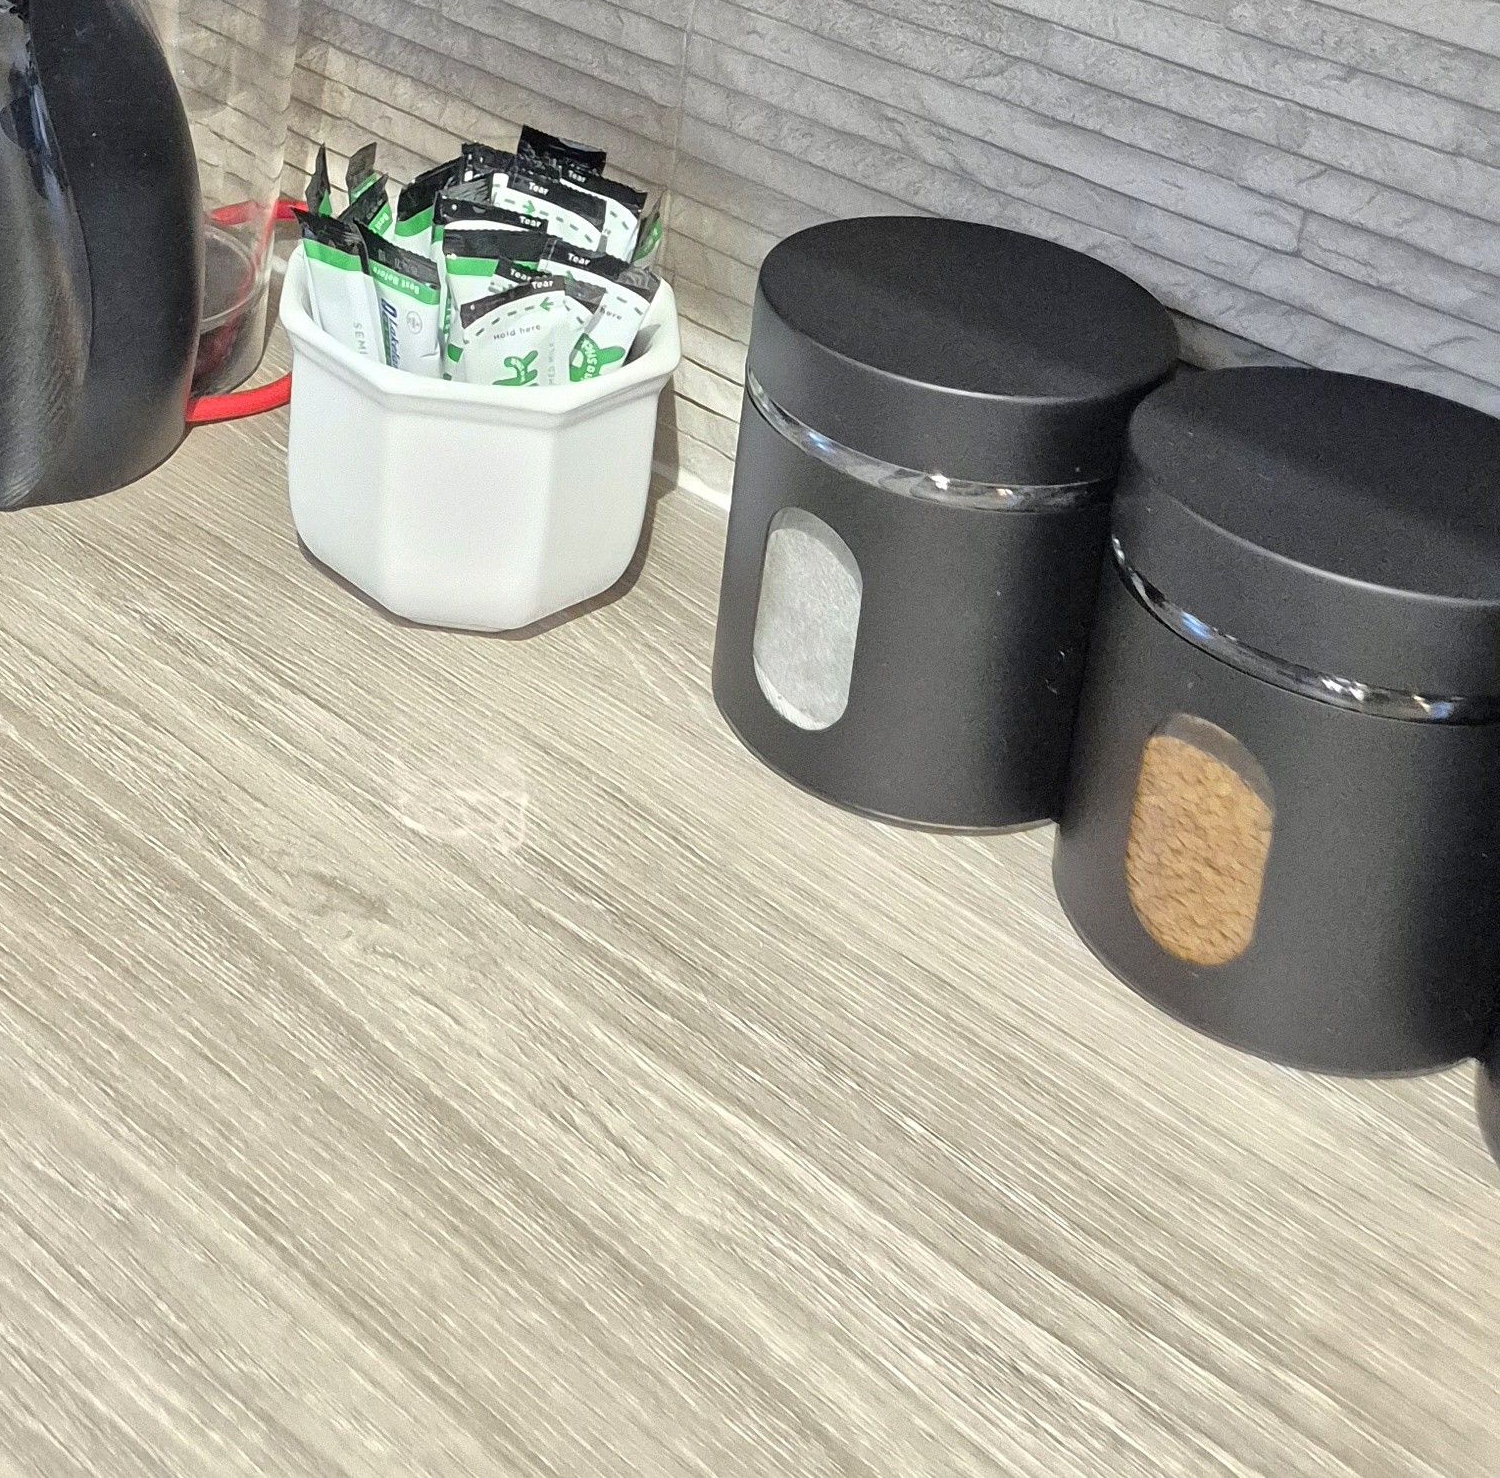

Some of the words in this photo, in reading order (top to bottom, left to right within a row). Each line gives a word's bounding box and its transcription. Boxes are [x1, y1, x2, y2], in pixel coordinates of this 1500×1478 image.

[528, 182, 549, 195] Tear
[519, 216, 542, 227] Tear
[567, 252, 591, 266] Tear
[531, 280, 553, 290] Tear
